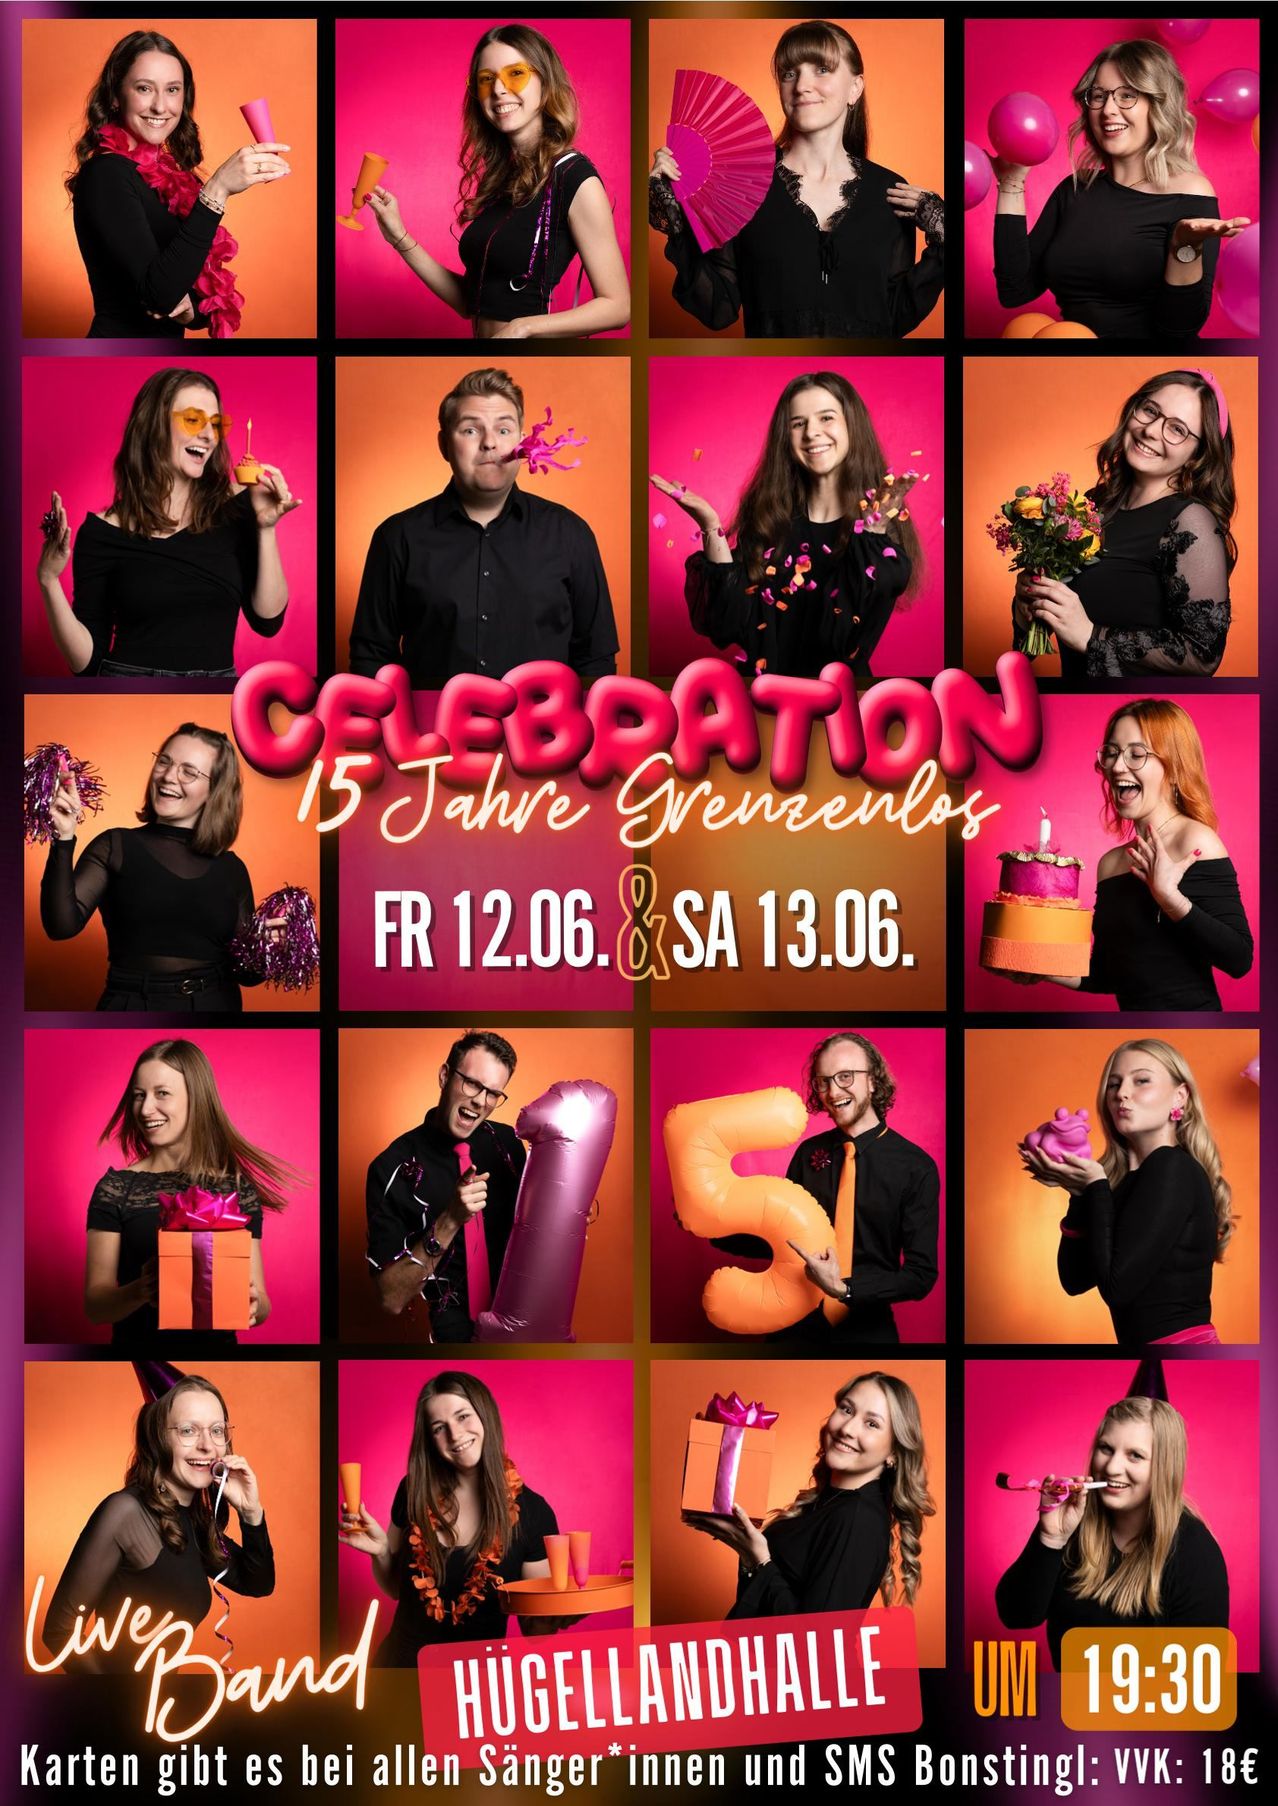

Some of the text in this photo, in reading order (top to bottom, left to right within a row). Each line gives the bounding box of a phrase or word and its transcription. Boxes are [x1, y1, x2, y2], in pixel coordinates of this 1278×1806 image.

[231, 651, 1043, 790] CELEBRATION
[296, 753, 1001, 848] 15 Jahre Grenzenlos
[374, 863, 914, 981] FR 12.06. & SA 13.06.
[24, 1575, 173, 1672] Live
[134, 1599, 379, 1743] Band
[453, 1624, 888, 1741] HÜGELLANDHALLE
[973, 1641, 1222, 1717] UM 19:30
[20, 1744, 139, 1786] Karten
[158, 1743, 228, 1796] gibt
[246, 1754, 283, 1786] es
[302, 1744, 353, 1786] bei
[373, 1744, 460, 1786] allen
[745, 1744, 805, 1786] und
[825, 1743, 896, 1787] SMS
[915, 1744, 1099, 1796] Bonstingl:
[1114, 1747, 1183, 1785] VVK:
[1202, 1747, 1259, 1785] 18€
